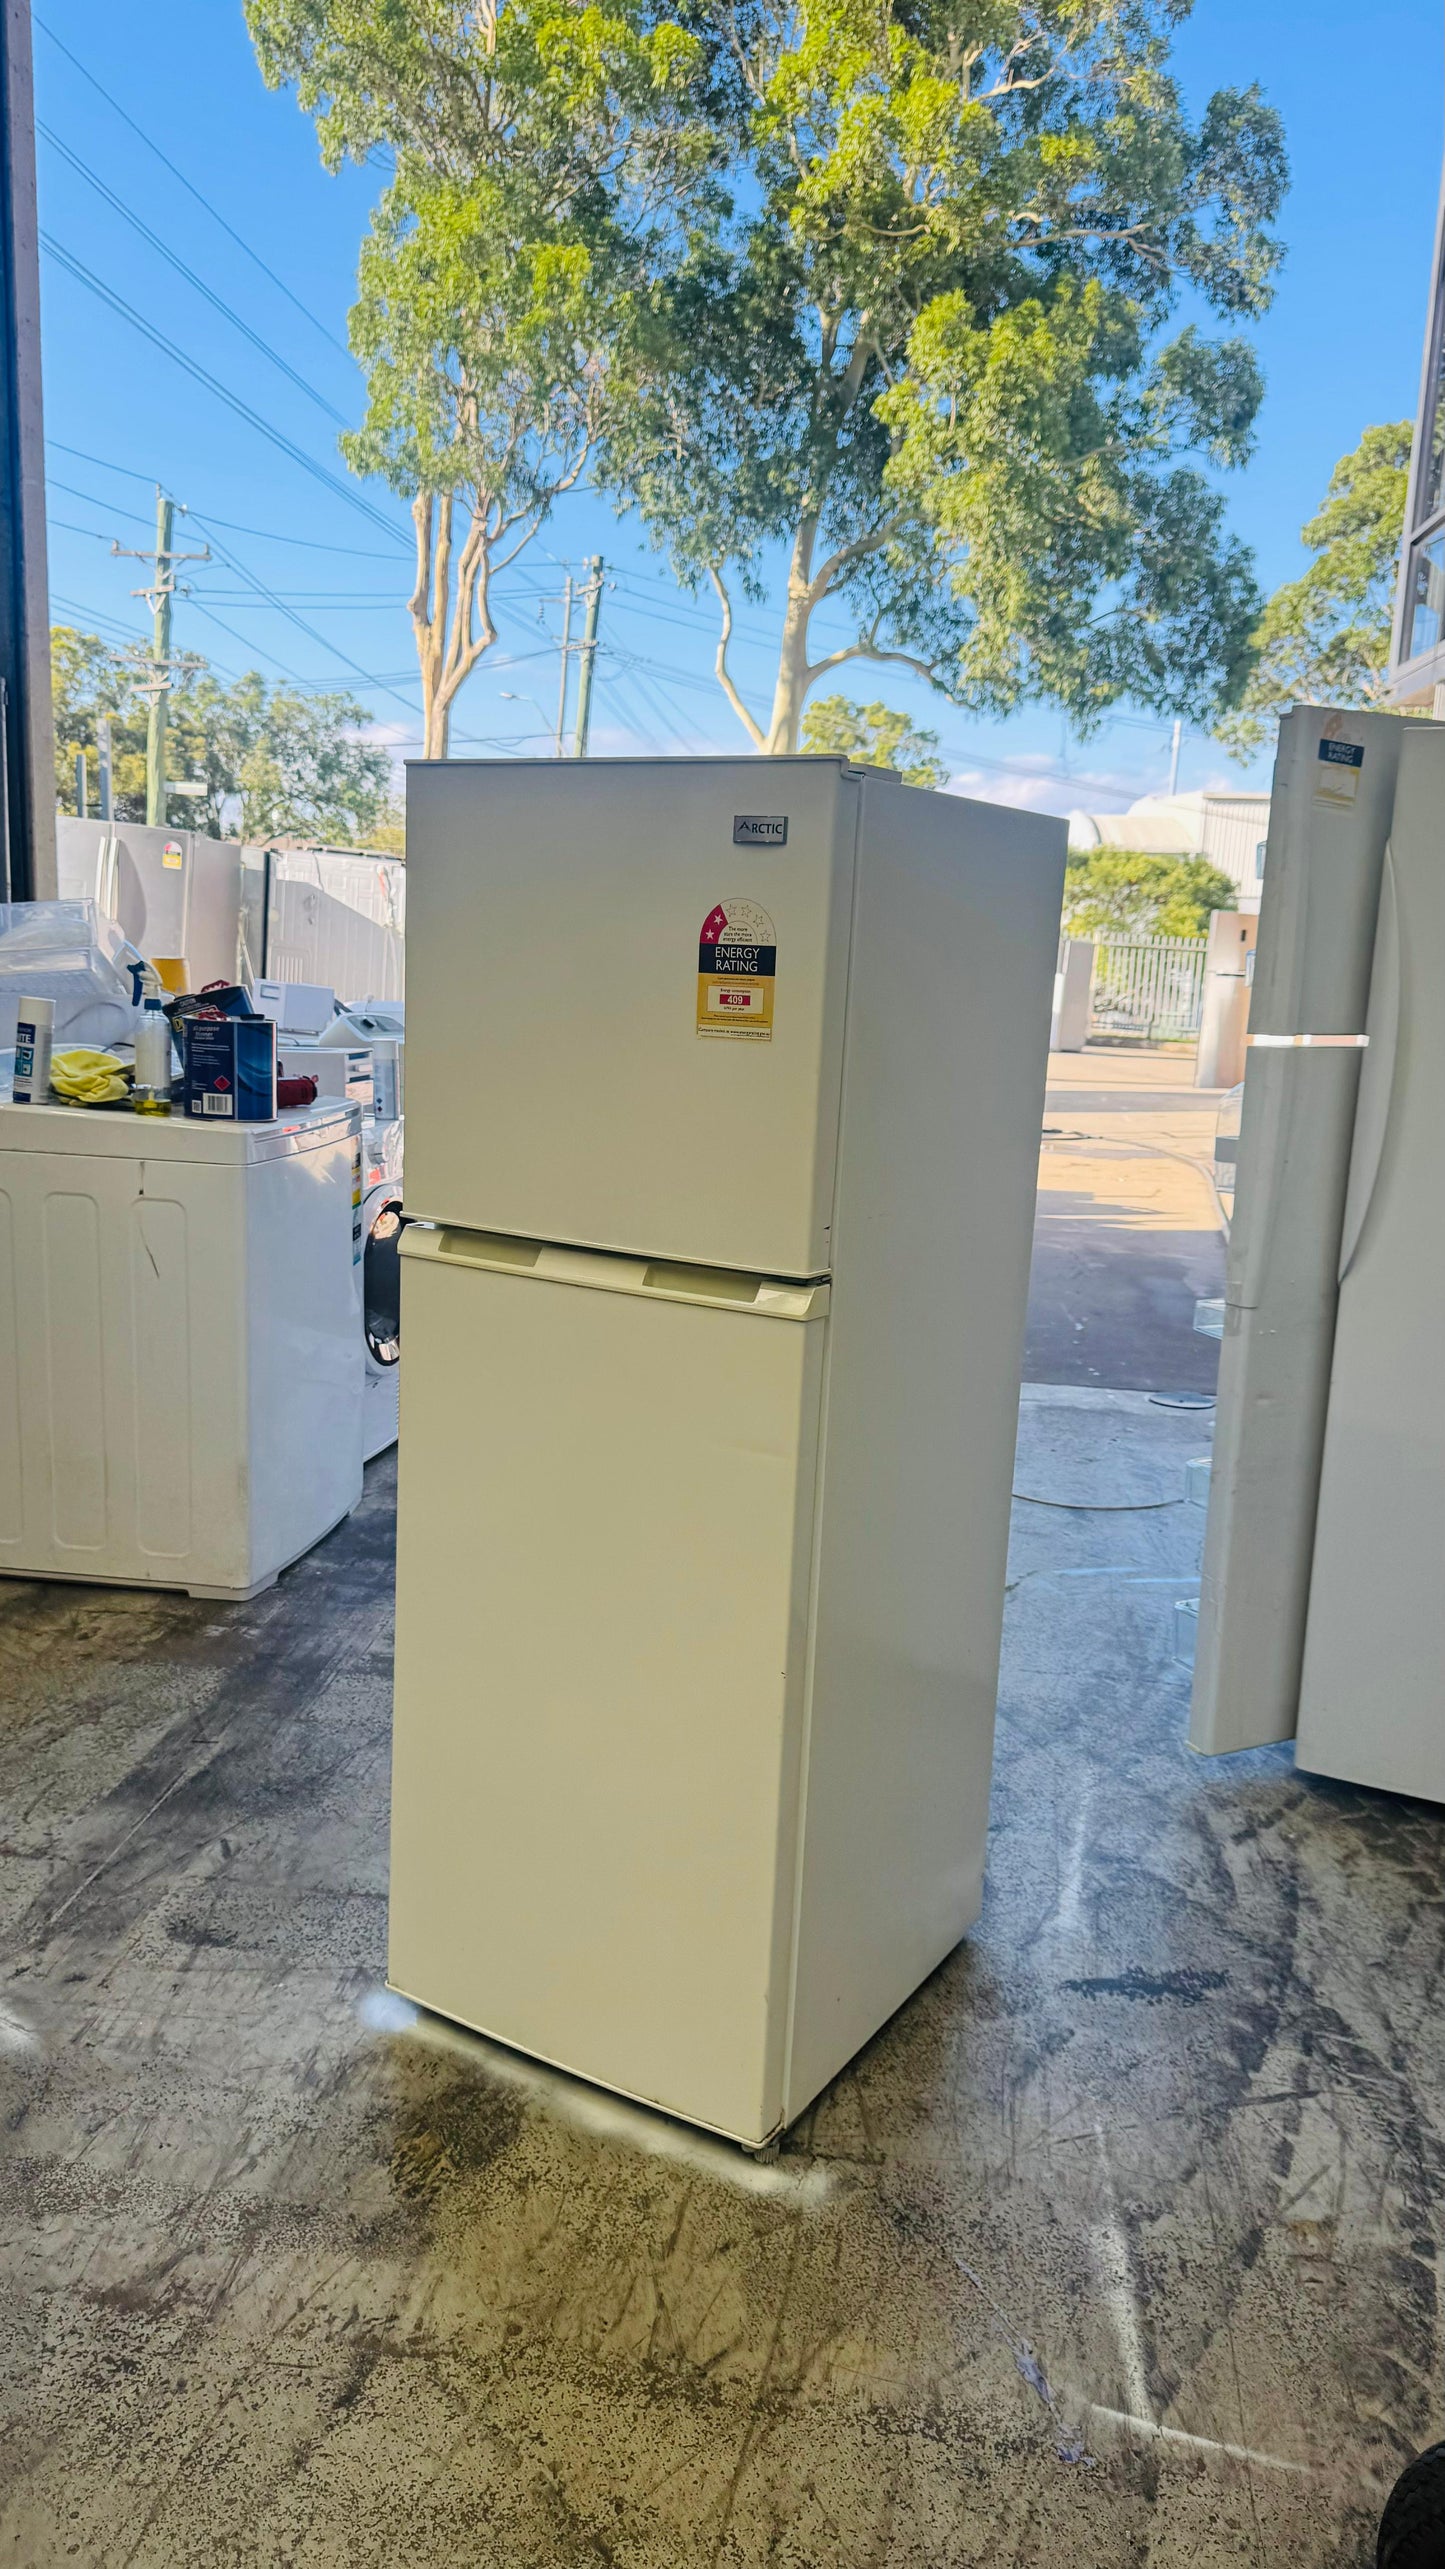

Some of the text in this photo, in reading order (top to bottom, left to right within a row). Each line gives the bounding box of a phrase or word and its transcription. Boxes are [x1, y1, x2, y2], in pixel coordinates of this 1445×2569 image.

[1328, 742, 1356, 754] ENERGY
[1328, 751, 1353, 763] RATING
[737, 821, 783, 834] ARCTIC
[715, 946, 760, 959] ENERGY
[715, 959, 758, 972] RATING
[727, 995, 743, 1005] 409
